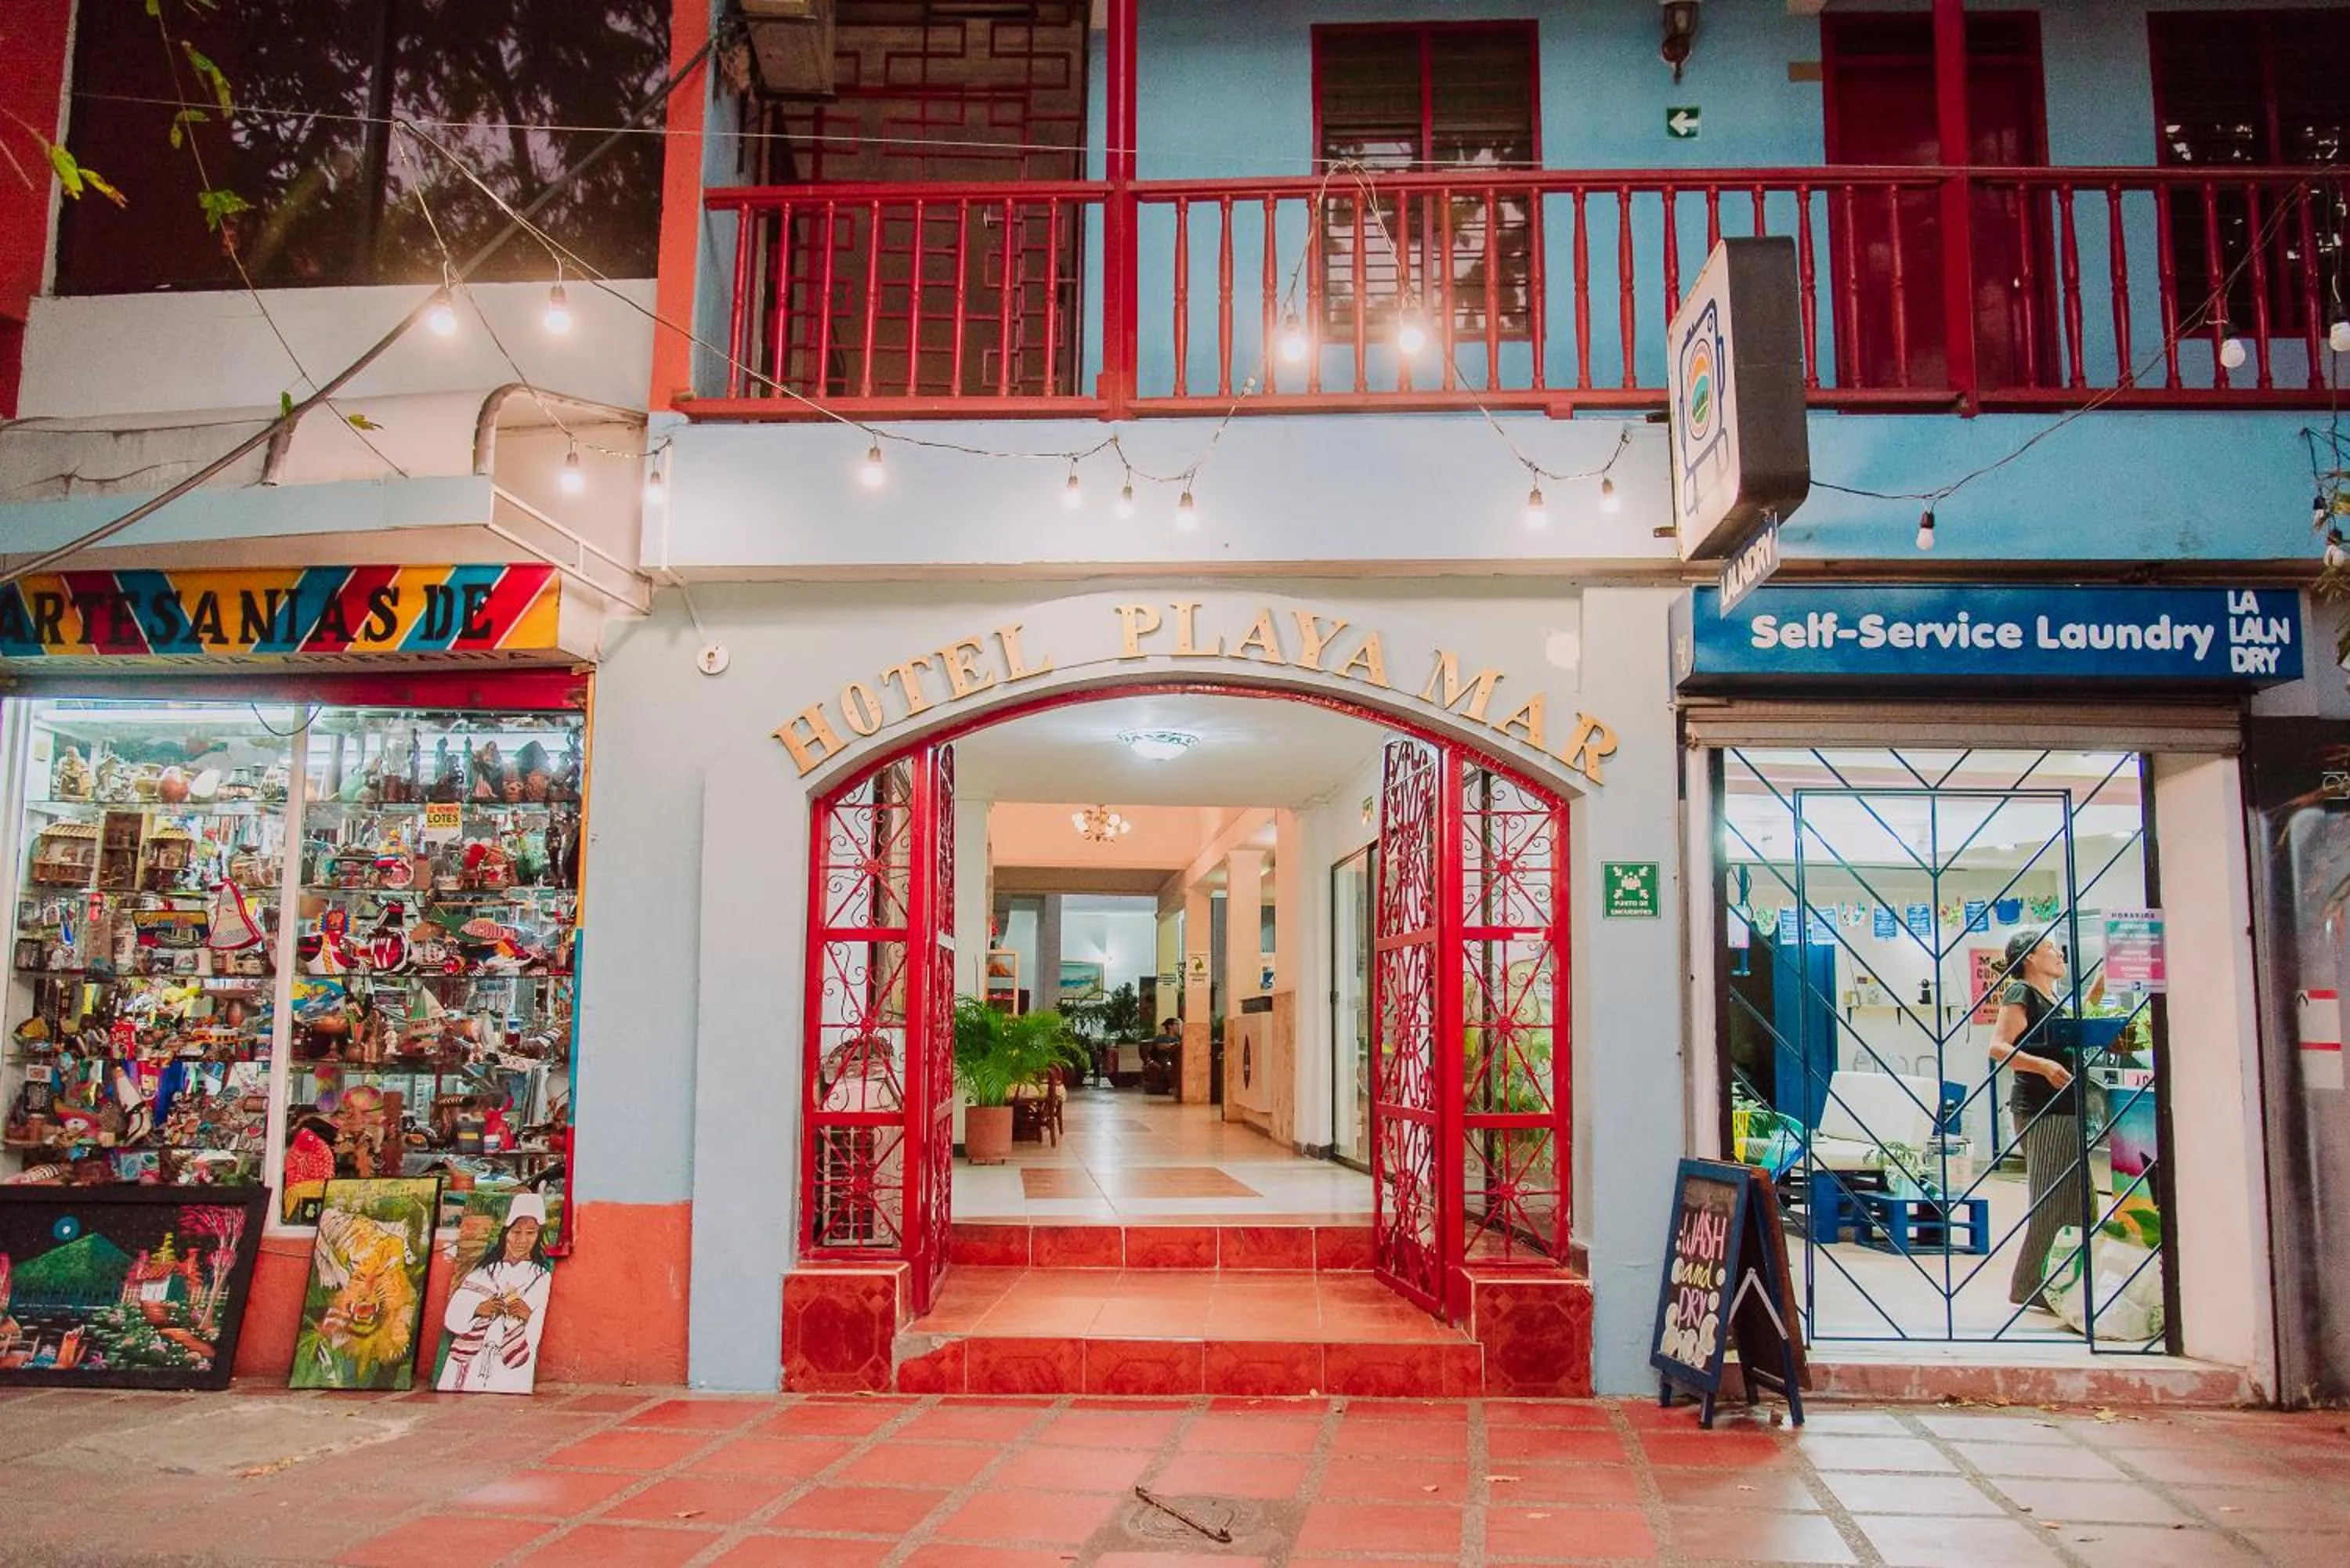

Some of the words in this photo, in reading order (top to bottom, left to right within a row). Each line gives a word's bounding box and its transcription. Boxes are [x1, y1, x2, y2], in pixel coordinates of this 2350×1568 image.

[1720, 526, 1773, 607] LAUNDRY
[0, 584, 400, 645] ARTESANIAS
[418, 583, 493, 641] DE
[2227, 590, 2260, 615] LA
[1751, 611, 2023, 649] Self-Service
[2037, 614, 2215, 661] Laundry
[2230, 646, 2281, 674] DRY
[772, 623, 1054, 779] HOTEL
[1114, 599, 1392, 690] PLAYA
[1415, 649, 1620, 786] MAR
[427, 813, 459, 824] LOTES
[1682, 1211, 1727, 1261] WASH
[1682, 1259, 1714, 1290] and
[1678, 1287, 1708, 1328] DRY
